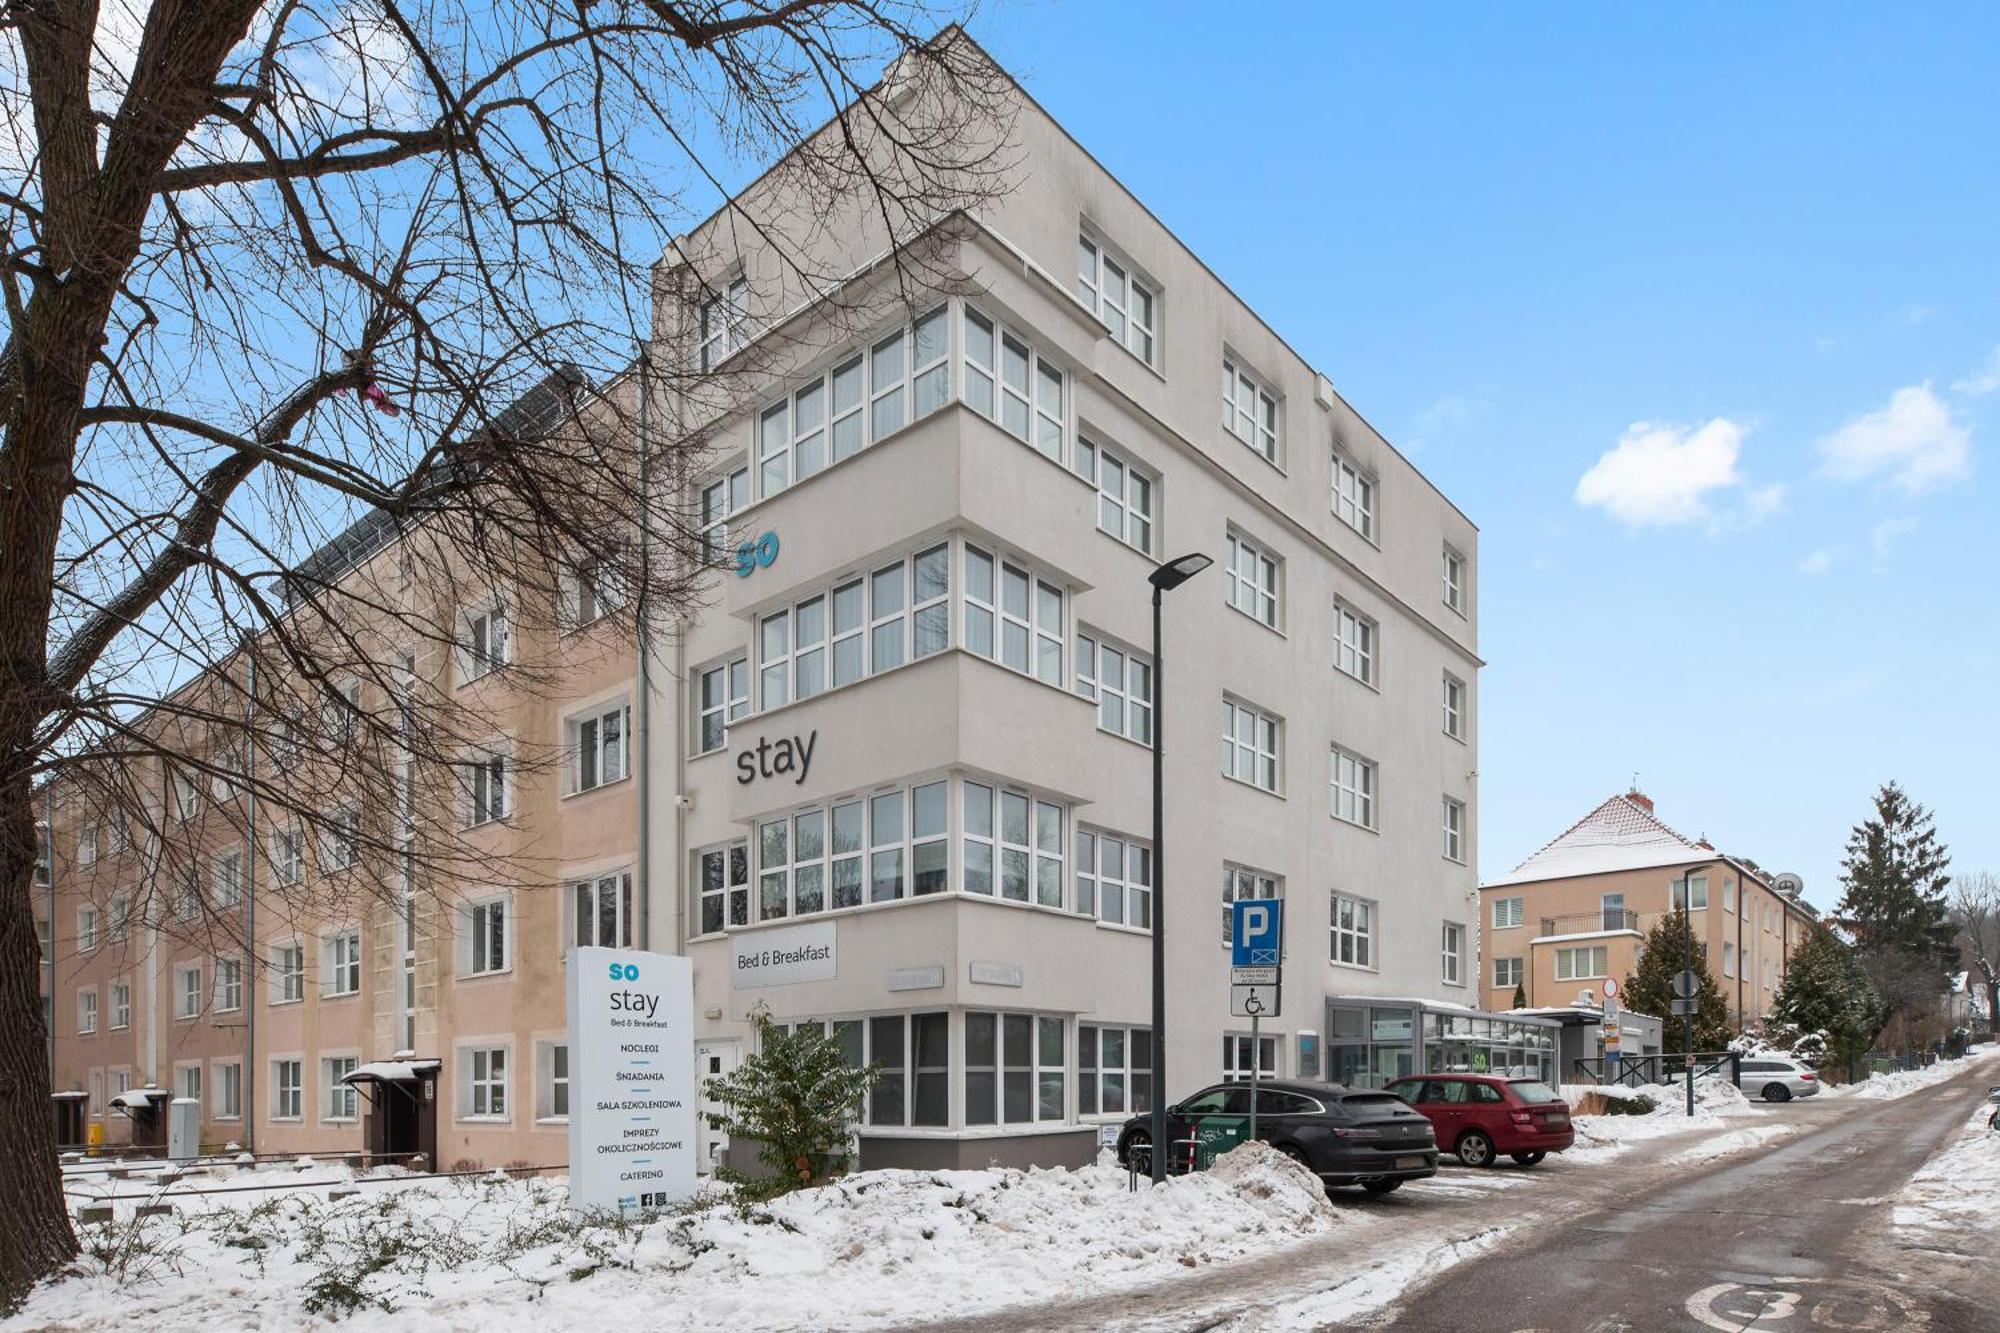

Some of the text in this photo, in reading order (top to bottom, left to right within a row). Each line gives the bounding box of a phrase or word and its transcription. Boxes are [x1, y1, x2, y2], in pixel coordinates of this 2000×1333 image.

[736, 531, 780, 577] so
[737, 729, 817, 785] stay
[1242, 906, 1269, 947] P
[738, 945, 830, 969] Bed & Breakfast
[608, 962, 640, 982] so
[610, 989, 660, 1019] stay
[610, 1018, 625, 1027] Bed
[634, 1019, 668, 1029] Breakfast
[620, 1044, 659, 1053] NOCLEGI
[616, 1071, 665, 1081] ŚNIADANIA
[597, 1100, 682, 1110] SALA SZKOLENIOWA
[623, 1128, 660, 1138] IMPREZY
[597, 1140, 682, 1154] OKOLICZNOŚCIOWE
[620, 1169, 664, 1181] CATERING
